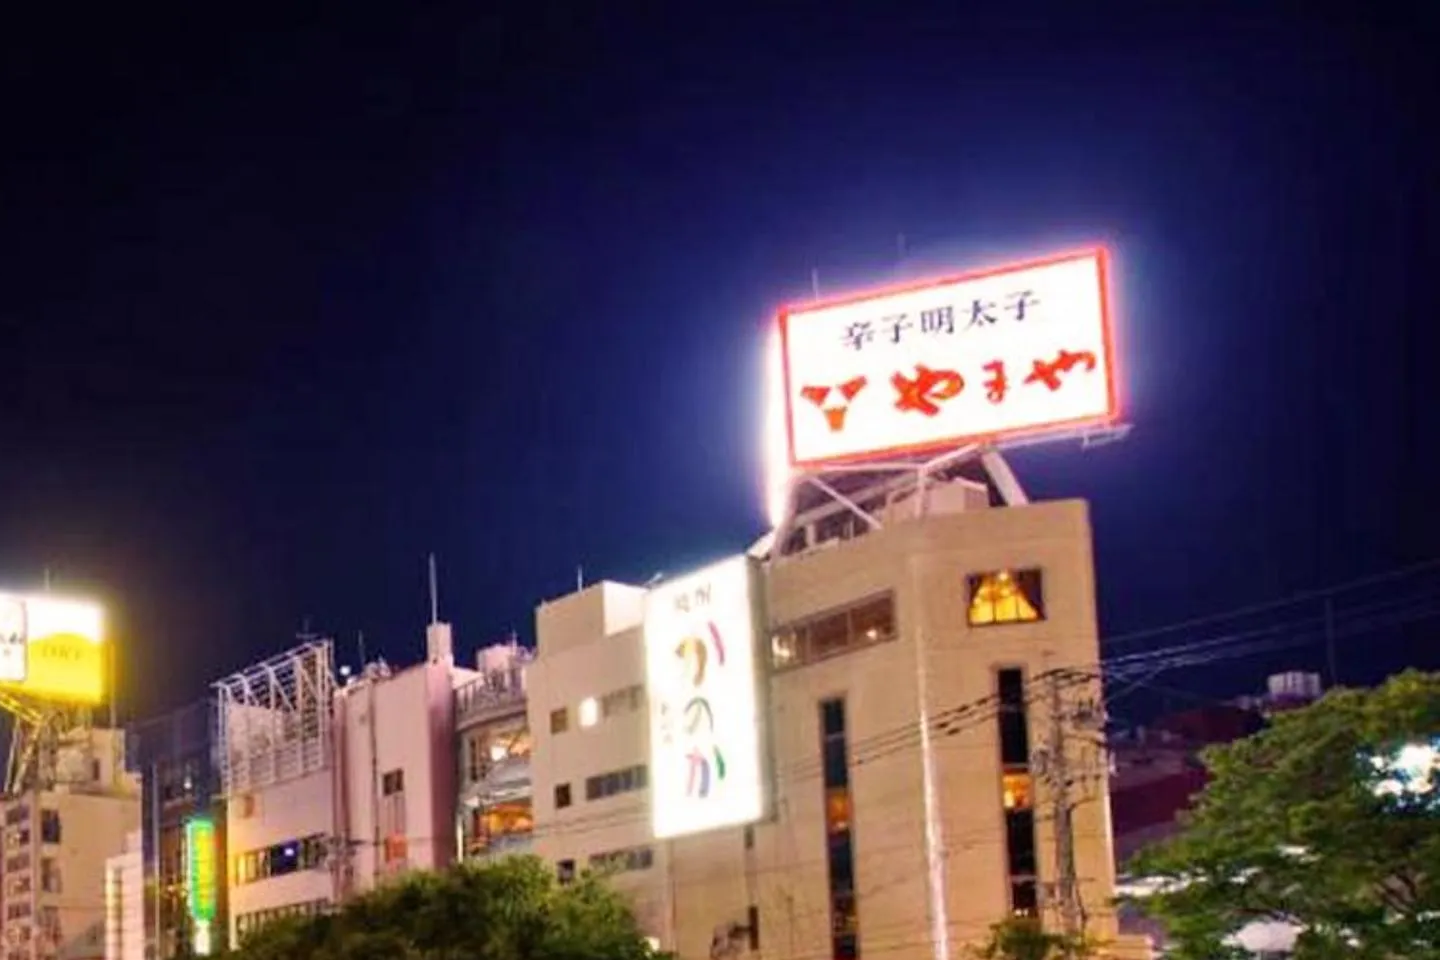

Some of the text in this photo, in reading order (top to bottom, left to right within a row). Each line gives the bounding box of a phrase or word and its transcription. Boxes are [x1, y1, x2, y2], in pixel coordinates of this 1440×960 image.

[840, 290, 1040, 350] 辛子明太子
[890, 350, 1096, 416] やまや
